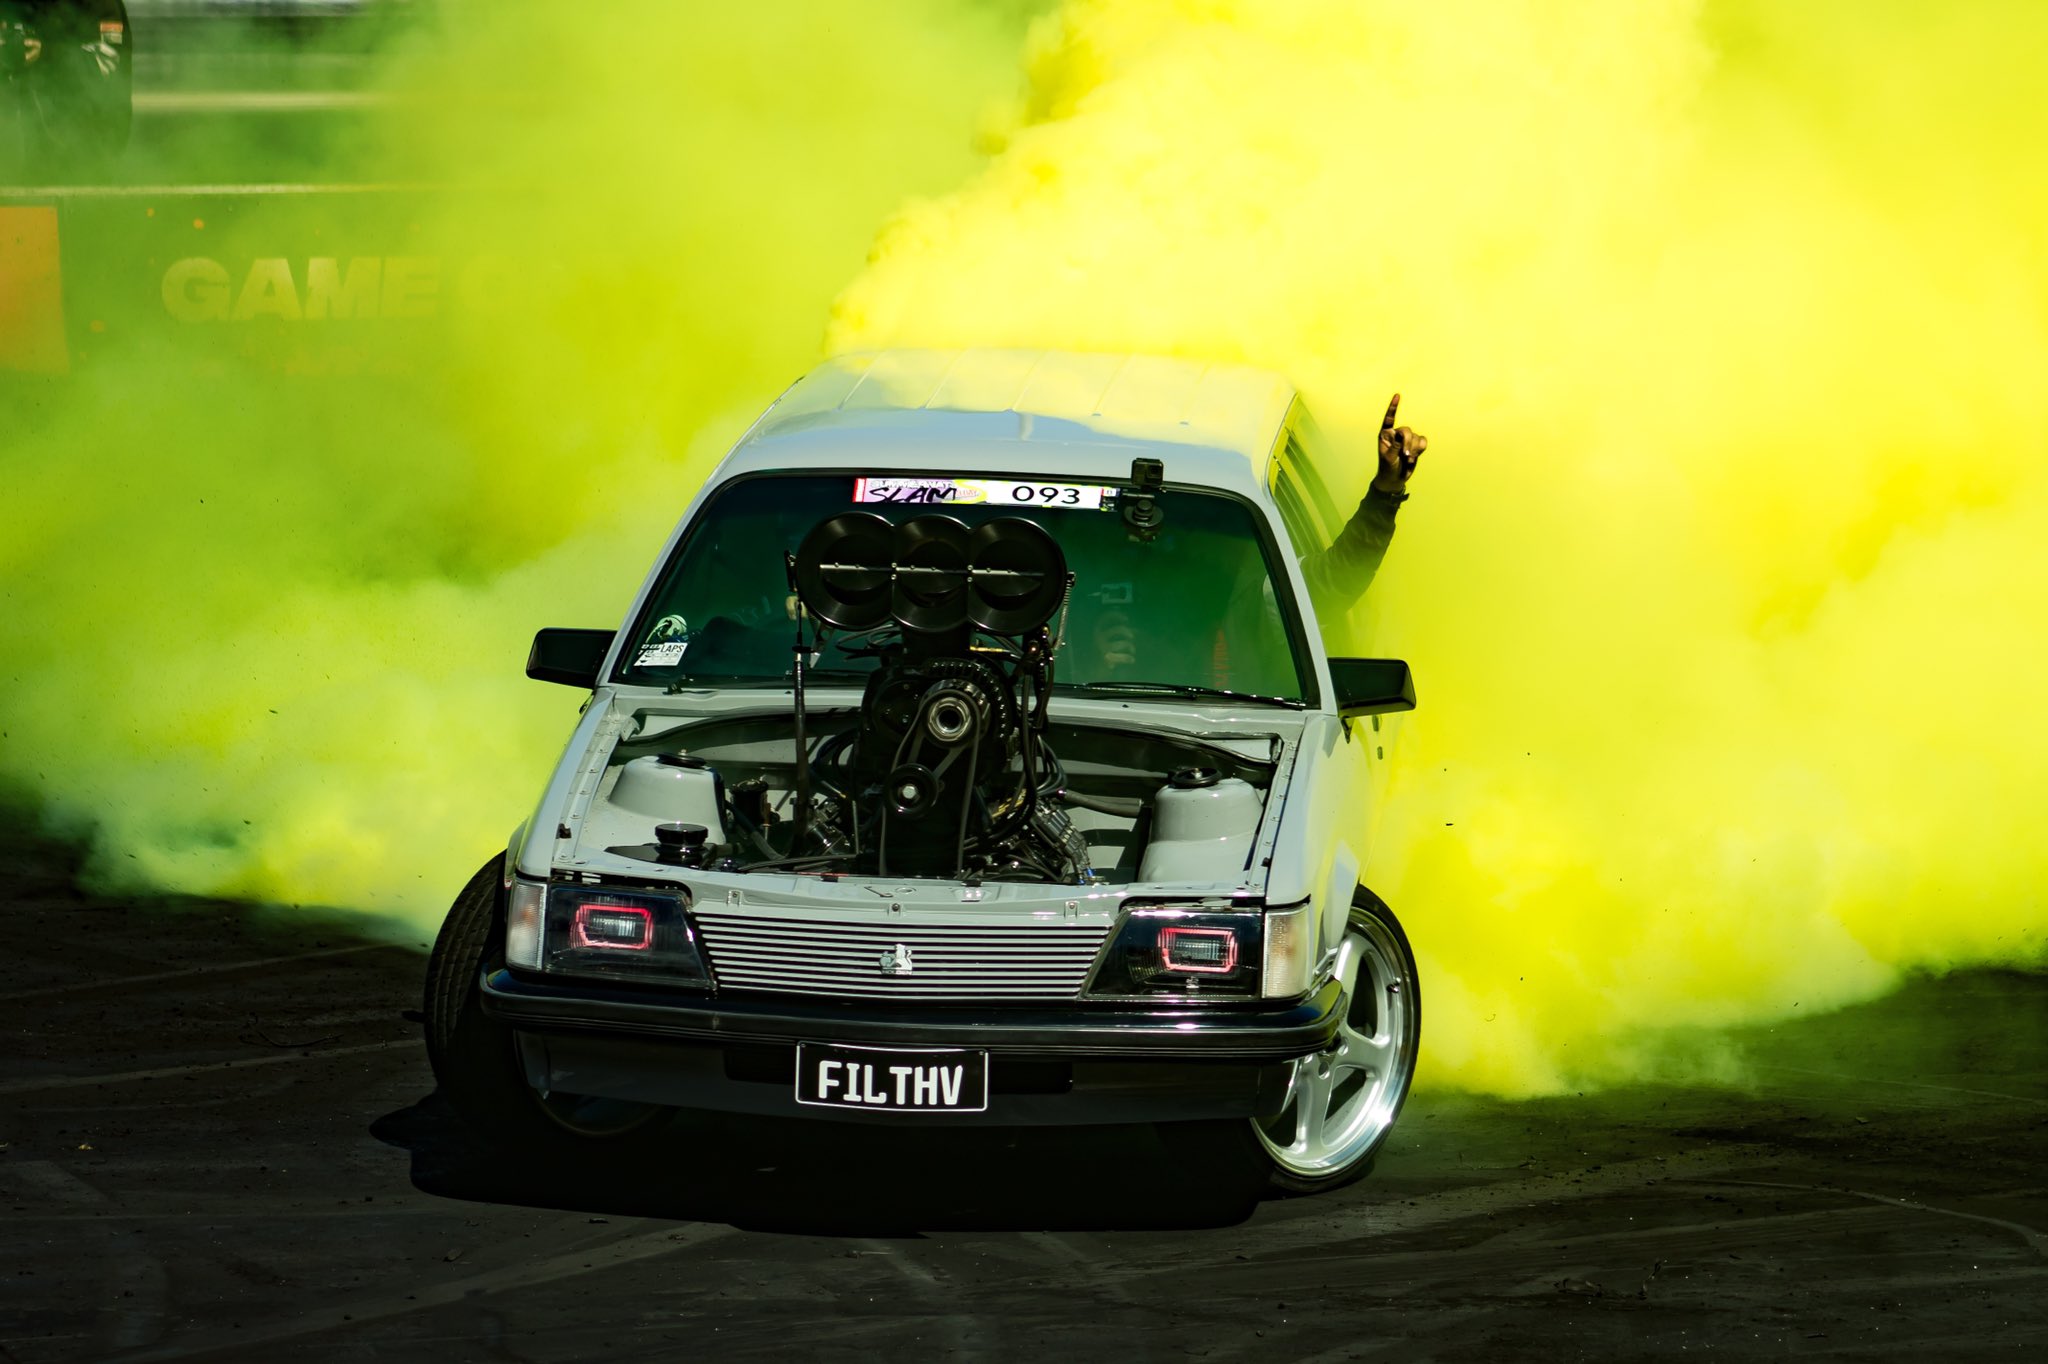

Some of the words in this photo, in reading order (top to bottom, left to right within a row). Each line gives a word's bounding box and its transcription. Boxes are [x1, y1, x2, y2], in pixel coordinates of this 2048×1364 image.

[161, 257, 440, 322] GAME
[869, 487, 957, 503] SLAM
[1012, 486, 1080, 504] 093
[660, 645, 684, 653] LAPS
[818, 1060, 963, 1106] FILTHV
